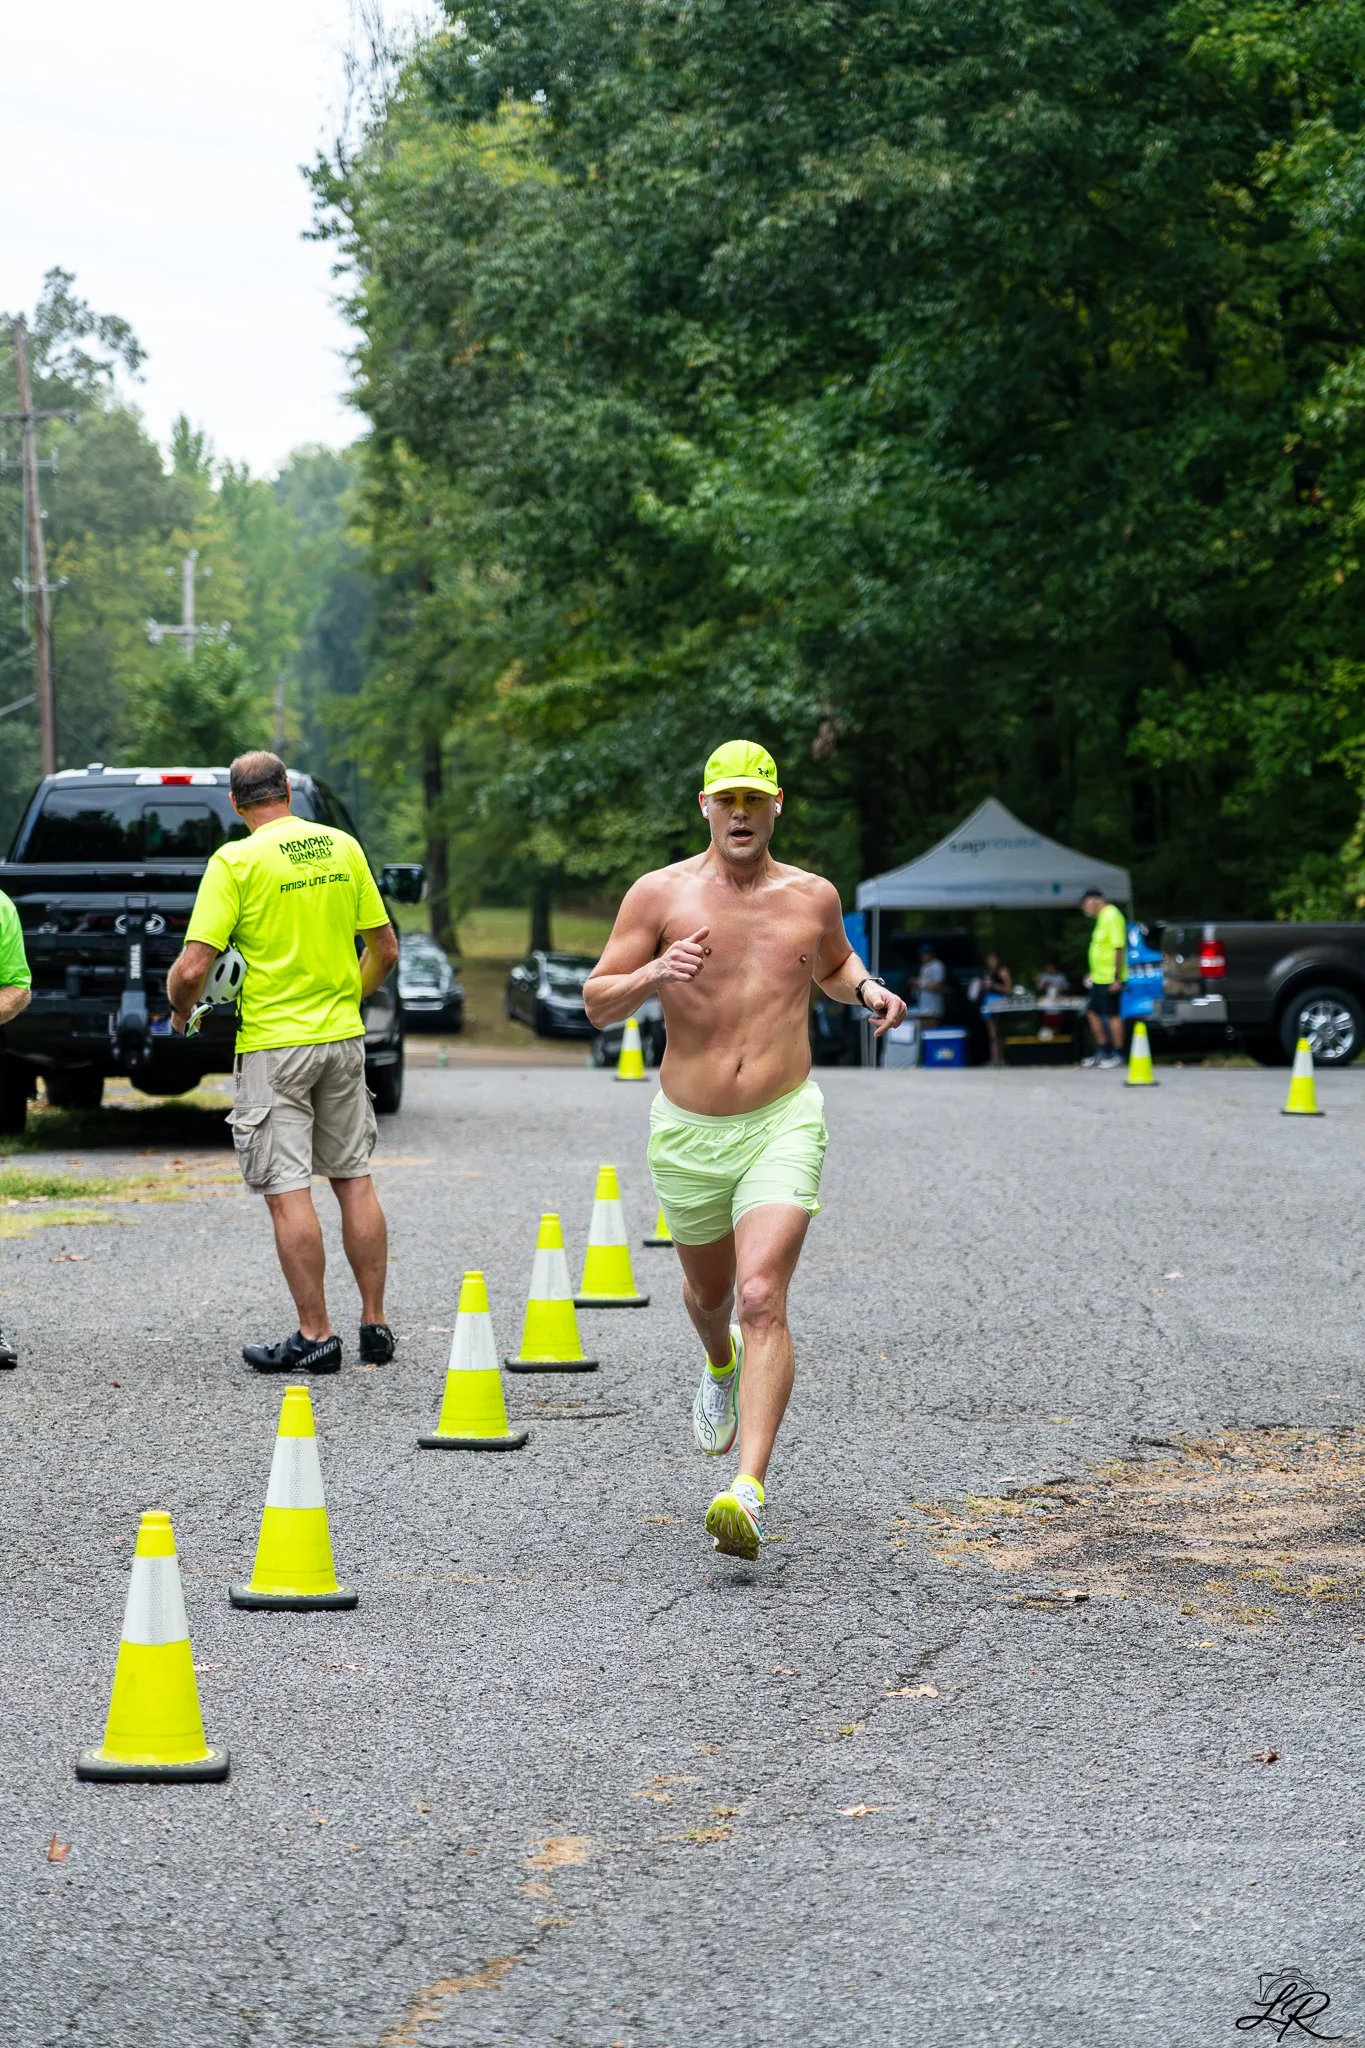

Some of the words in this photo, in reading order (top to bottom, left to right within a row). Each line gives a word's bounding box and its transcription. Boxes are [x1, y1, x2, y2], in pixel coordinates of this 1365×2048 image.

[279, 835, 334, 855] MEMPHIS
[288, 847, 332, 863] RUNNERS
[280, 879, 307, 893] FINISH
[309, 875, 327, 887] LINE
[328, 873, 349, 882] CREW
